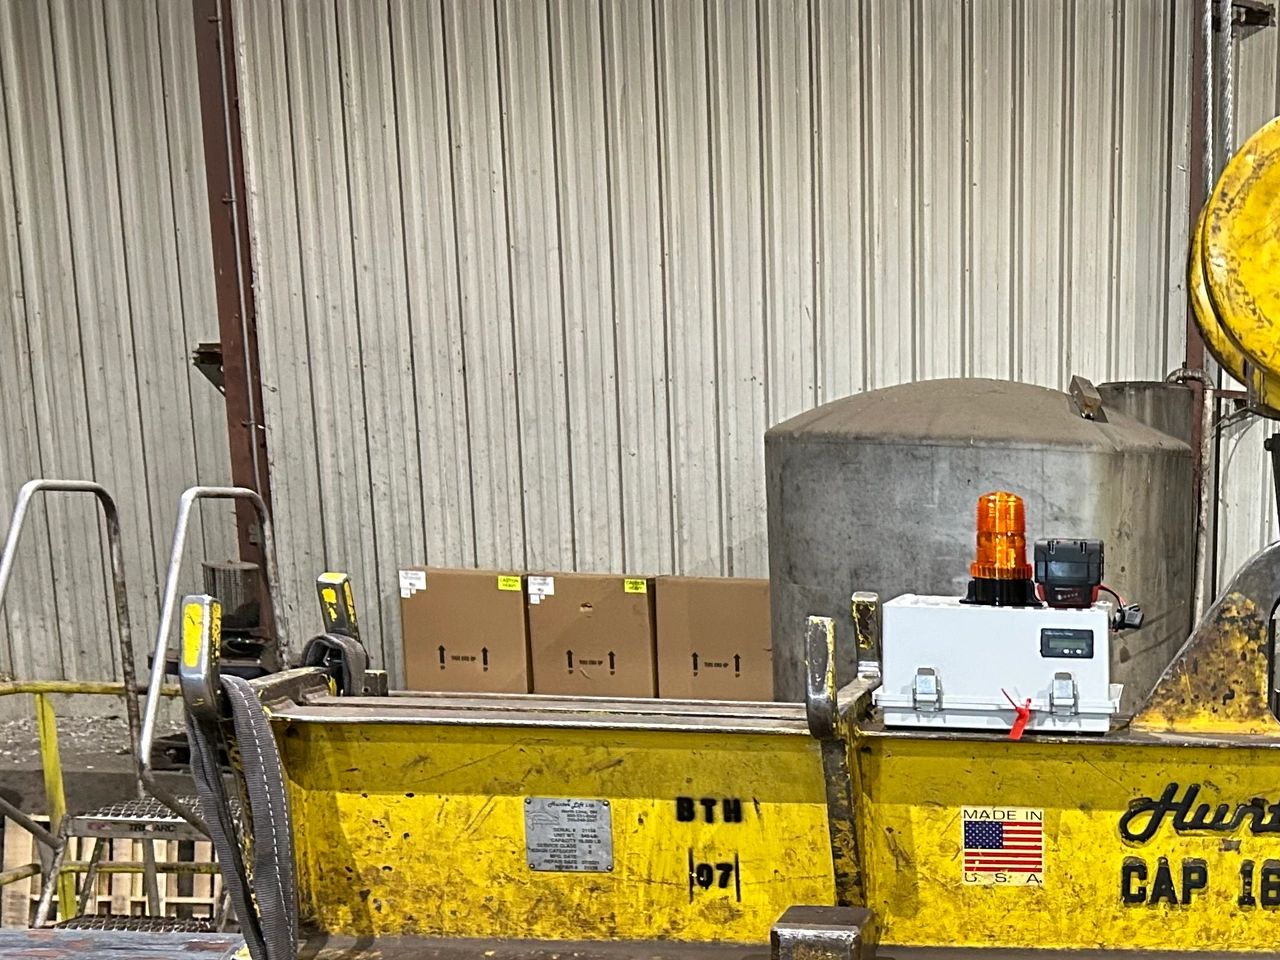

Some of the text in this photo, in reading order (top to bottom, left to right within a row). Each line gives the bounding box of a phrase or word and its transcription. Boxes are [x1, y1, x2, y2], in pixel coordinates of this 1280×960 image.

[676, 796, 743, 824] BTH
[963, 809, 1043, 821] MADE IN
[1120, 856, 1208, 909] CAP
